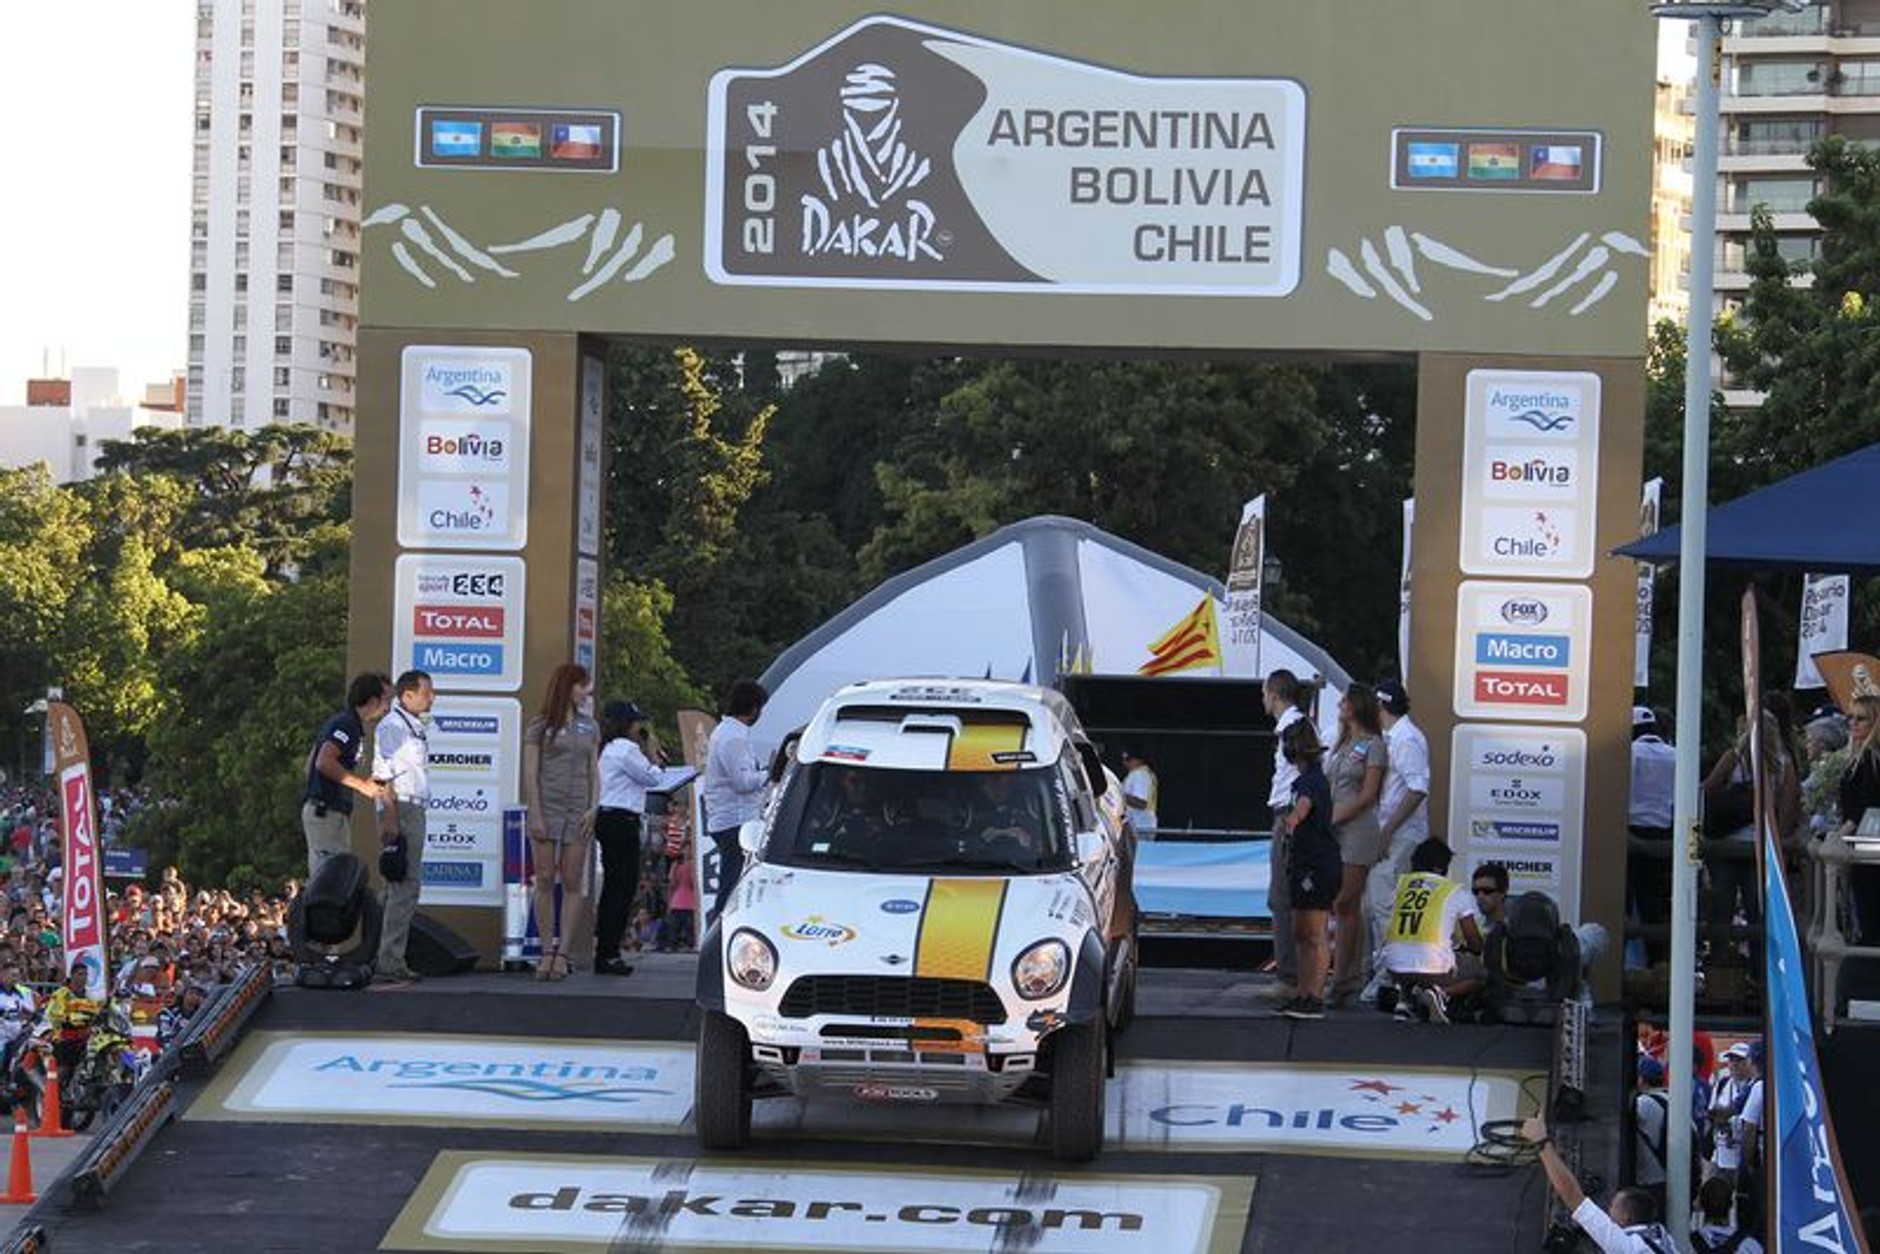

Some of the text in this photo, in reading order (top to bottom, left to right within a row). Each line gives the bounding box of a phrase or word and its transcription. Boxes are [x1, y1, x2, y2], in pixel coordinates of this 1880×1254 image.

[987, 109, 1276, 150] ARGENTINA
[744, 101, 778, 253] 2014
[1070, 167, 1271, 206] BOLIVIA
[801, 194, 944, 262] DAKAR
[1133, 225, 1270, 263] CHILE
[425, 365, 502, 386] Argentina
[1490, 390, 1570, 412] Argentina
[427, 434, 503, 457] Bolivia
[1491, 459, 1570, 483] Bolivia
[430, 510, 482, 530] Chile
[1494, 537, 1548, 557] Chile
[1510, 603, 1539, 615] FOX
[420, 611, 498, 631] TOTAL
[423, 647, 493, 669] Macro
[1486, 638, 1559, 660] Macro
[1481, 678, 1561, 698] TOTAL
[1482, 749, 1555, 767] sodexo
[430, 795, 488, 811] odexo
[1490, 788, 1541, 800] EDOX
[427, 833, 477, 844] EDOX
[69, 783, 93, 944] TOTAL
[1399, 890, 1430, 910] 26
[1398, 911, 1424, 935] TV
[313, 1054, 659, 1082] Argentina
[1149, 1104, 1400, 1132] Chile
[508, 1186, 1143, 1231] dakar.com
